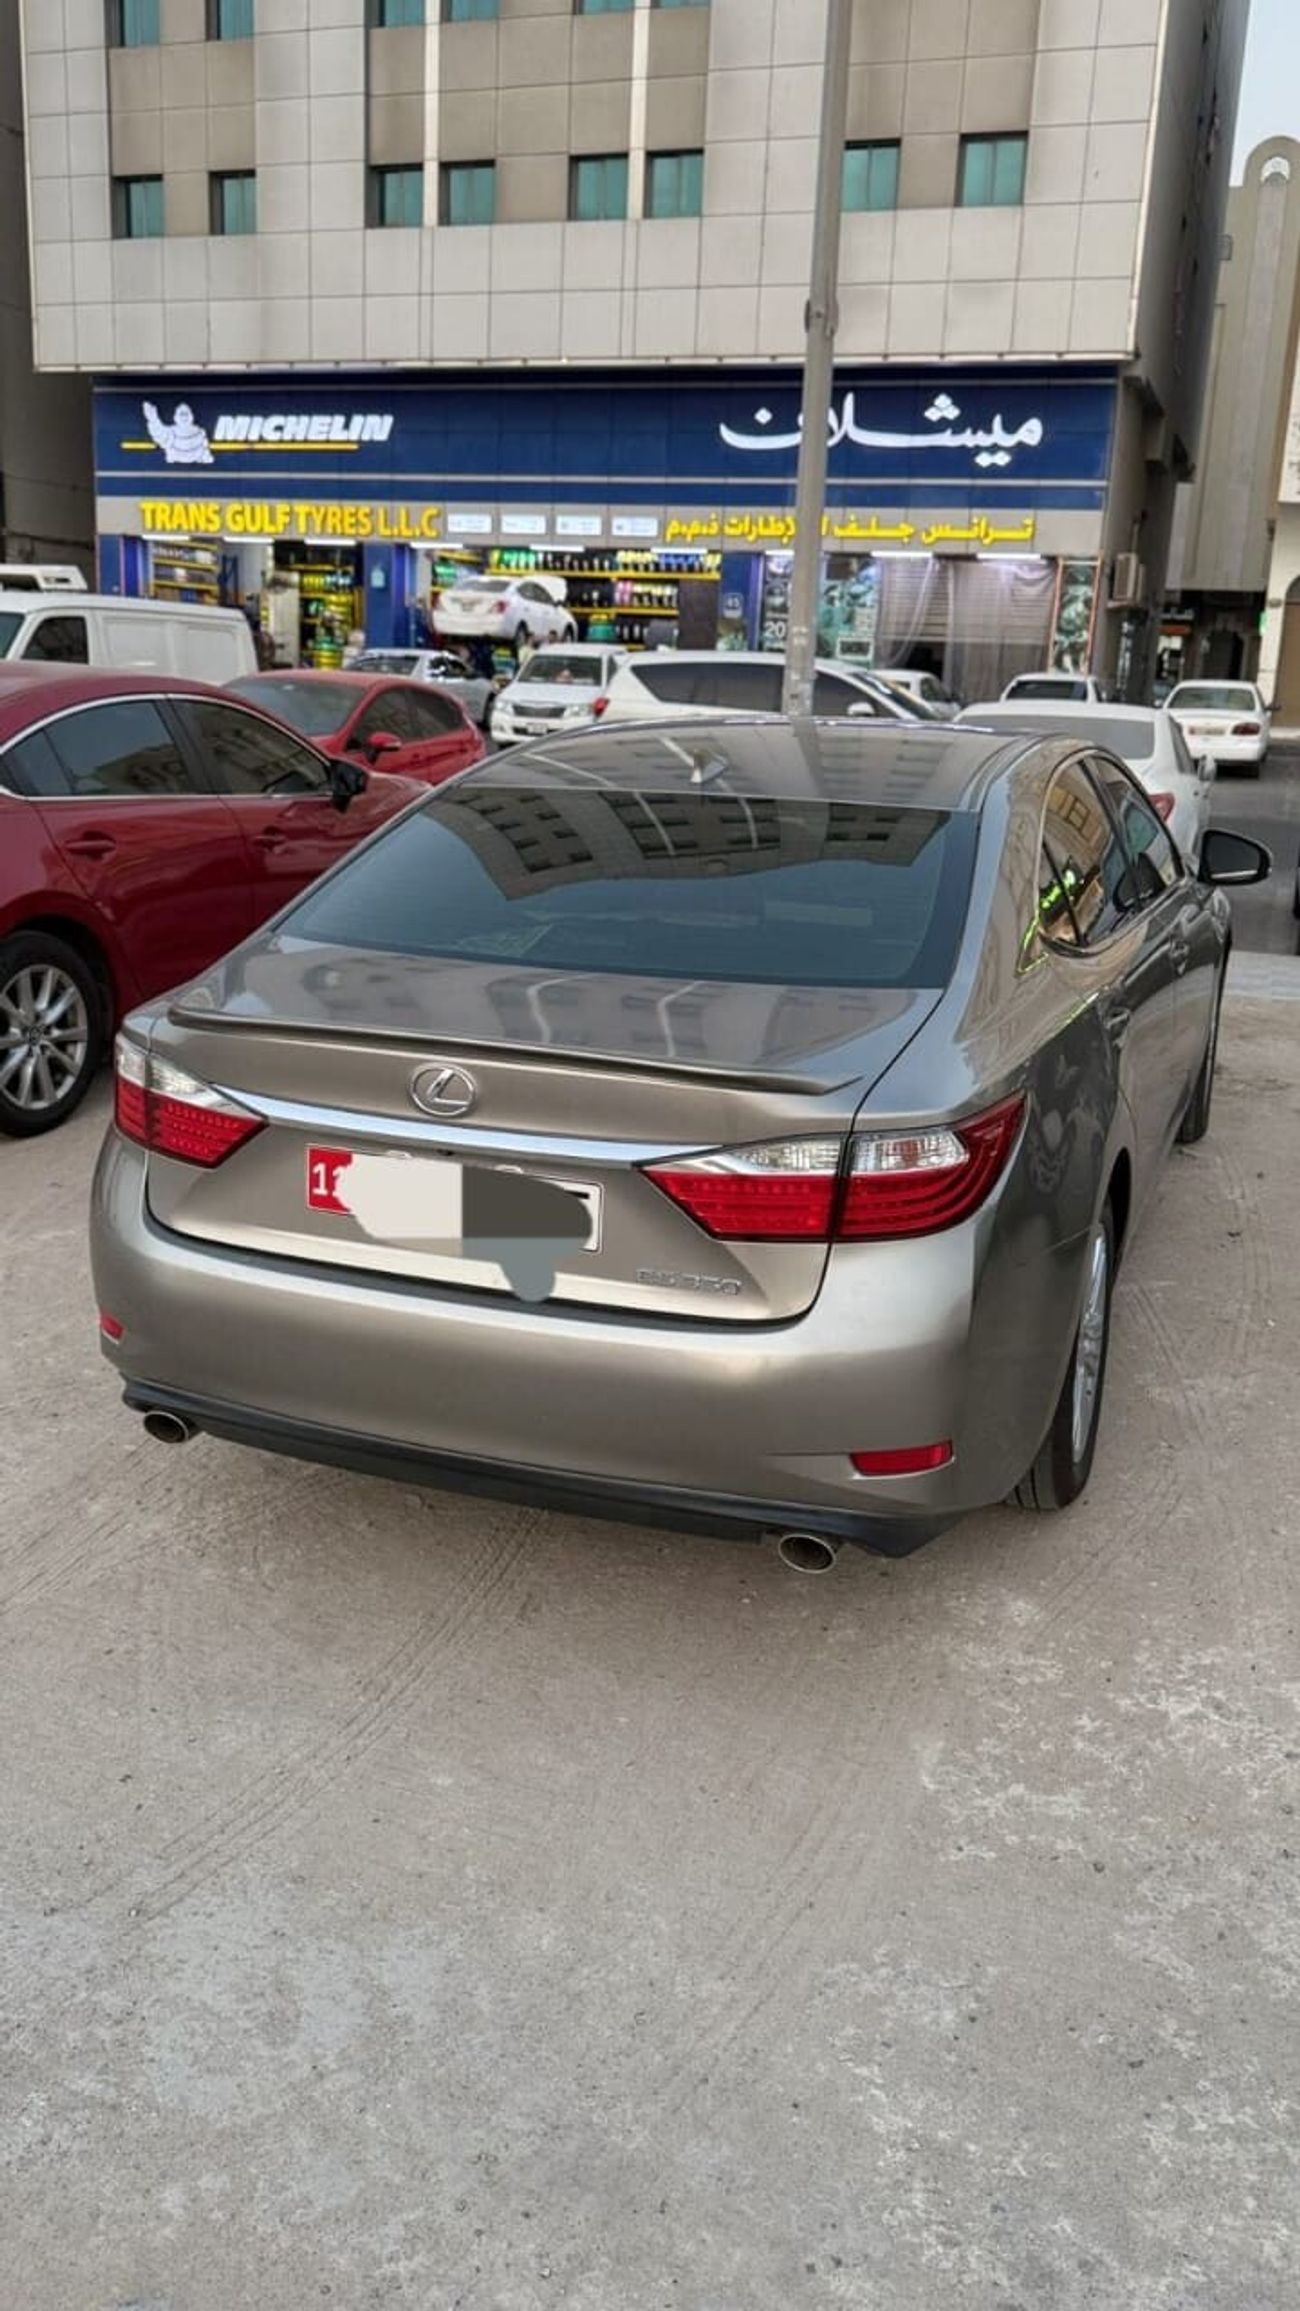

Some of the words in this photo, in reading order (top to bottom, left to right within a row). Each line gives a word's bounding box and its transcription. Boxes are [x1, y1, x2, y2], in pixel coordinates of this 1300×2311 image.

[213, 414, 394, 441] MICHELIN
[719, 392, 1043, 468] ميشلان
[140, 500, 221, 532] TRANS
[225, 503, 290, 535] GULF
[293, 504, 371, 536] TYRES
[377, 506, 440, 538] L.L.C
[833, 514, 914, 543] جلف
[921, 516, 1034, 544] ترانس
